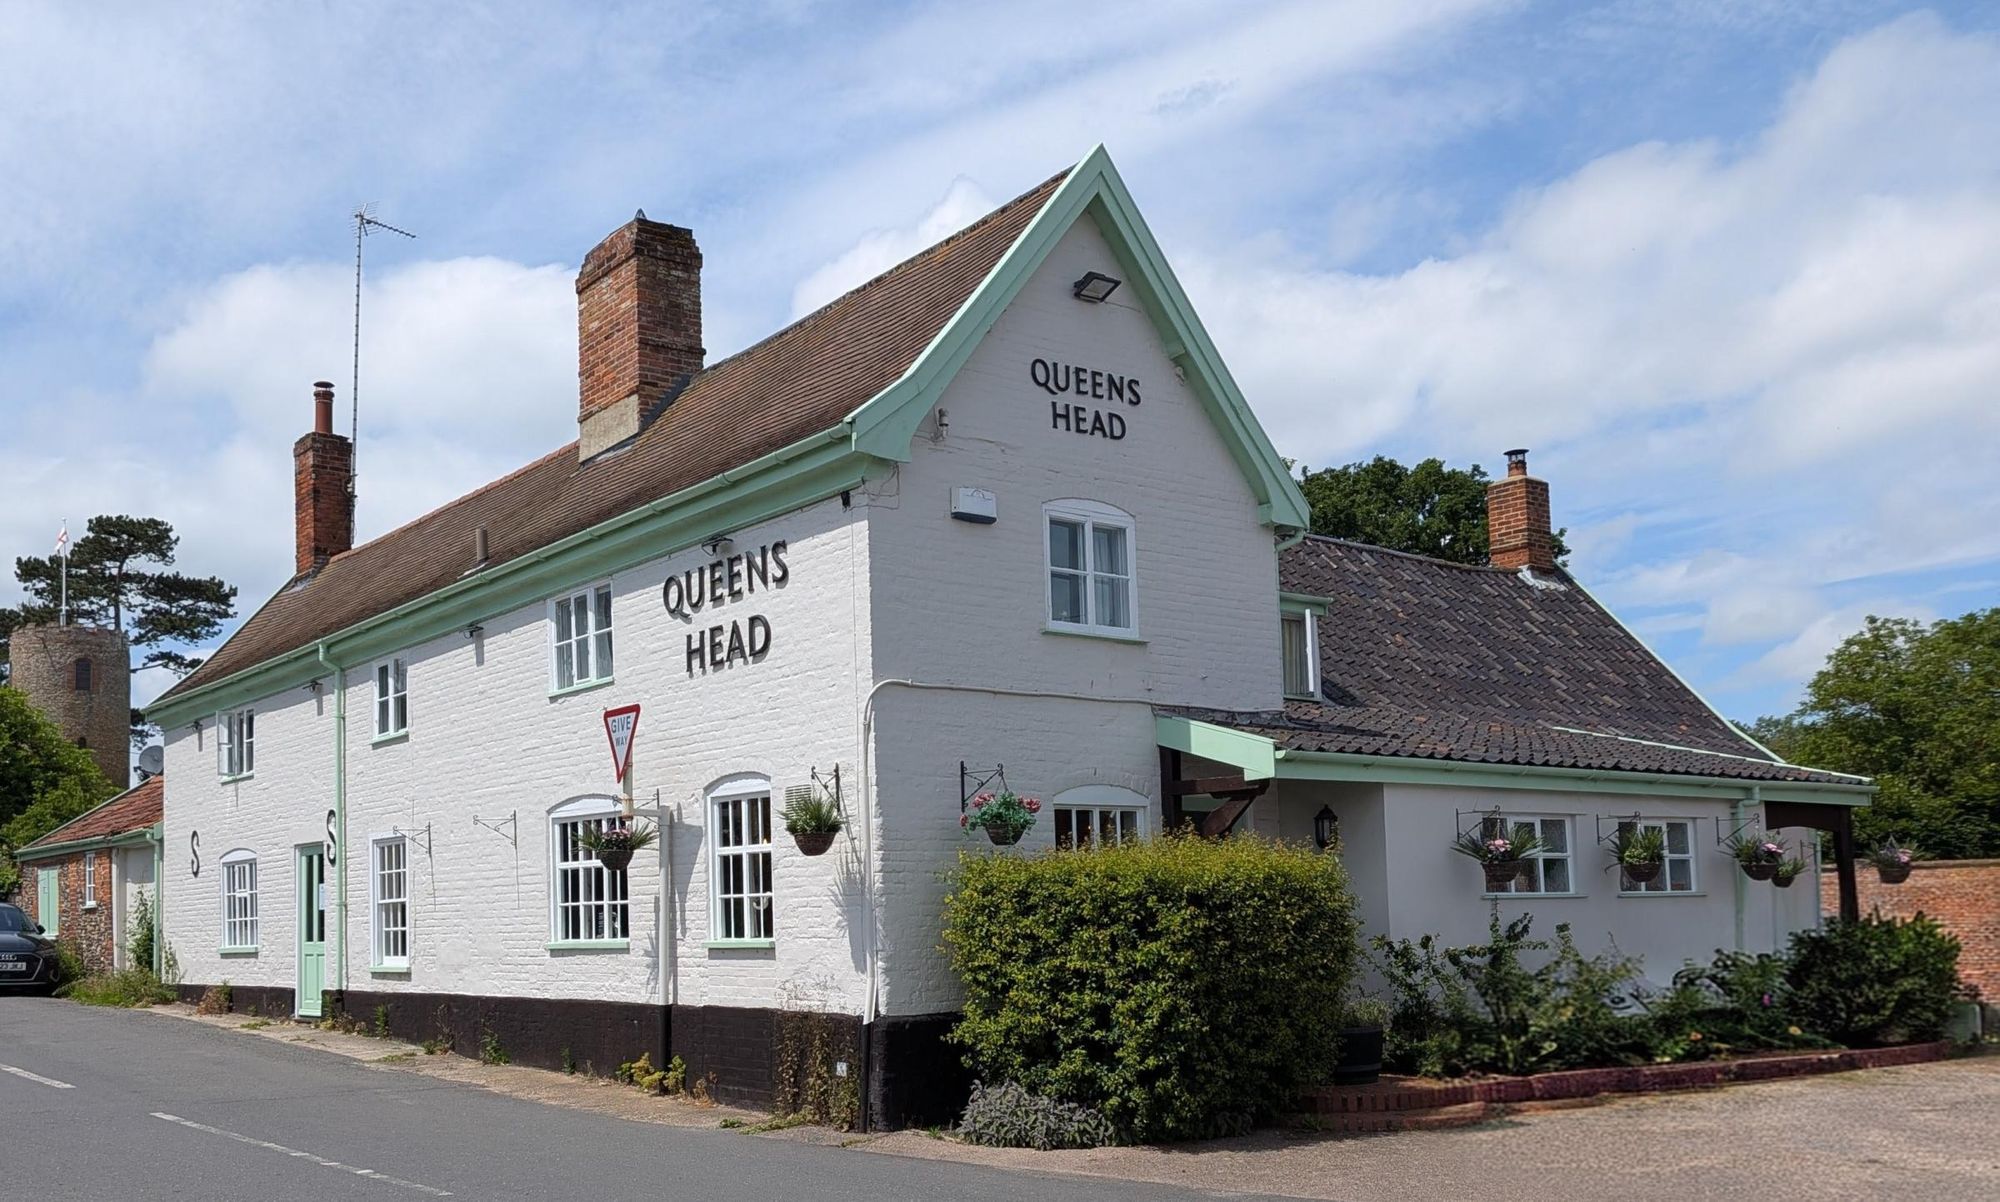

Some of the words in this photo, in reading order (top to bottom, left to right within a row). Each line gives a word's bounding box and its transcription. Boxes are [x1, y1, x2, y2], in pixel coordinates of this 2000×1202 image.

[1031, 358, 1142, 406] QUEENS
[1051, 401, 1127, 440] HEAD
[663, 540, 789, 619] QUEENS
[686, 614, 772, 673] HEAD
[611, 715, 631, 734] GIVE
[615, 735, 628, 747] WAY
